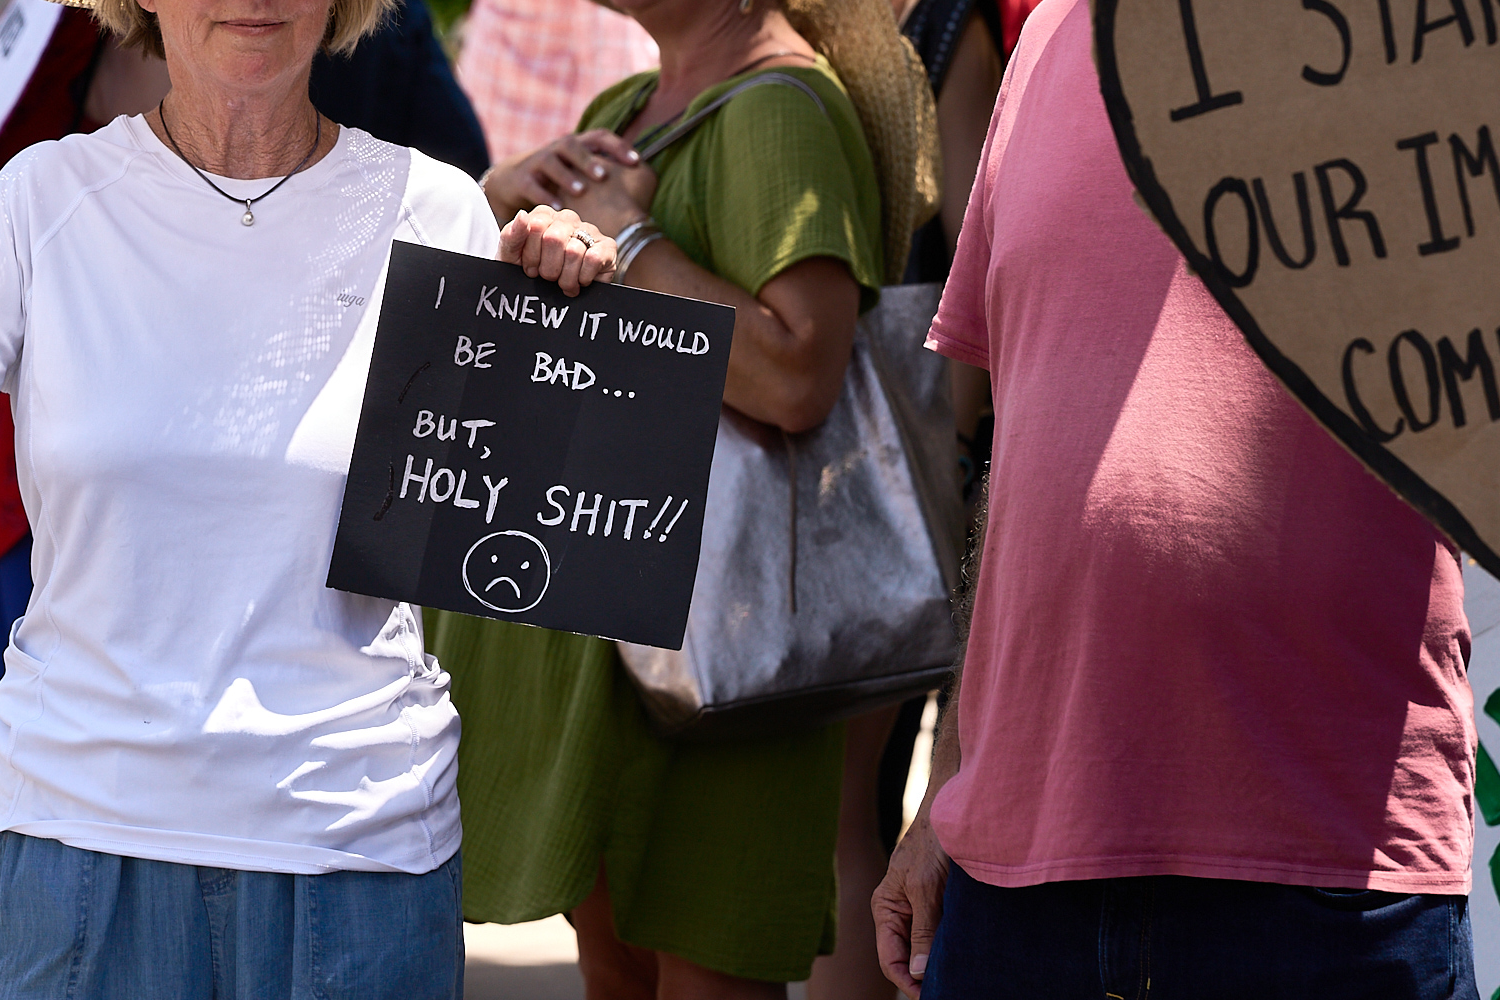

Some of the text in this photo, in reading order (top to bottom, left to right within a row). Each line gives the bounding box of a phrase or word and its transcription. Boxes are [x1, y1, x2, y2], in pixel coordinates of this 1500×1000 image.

[1203, 158, 1388, 289] OUR
[434, 276, 710, 355] I KNEW IT WOULD
[454, 335, 636, 399] BE BAD...
[412, 409, 497, 460] BUT,
[399, 454, 690, 543] HOLY SHIT!!
